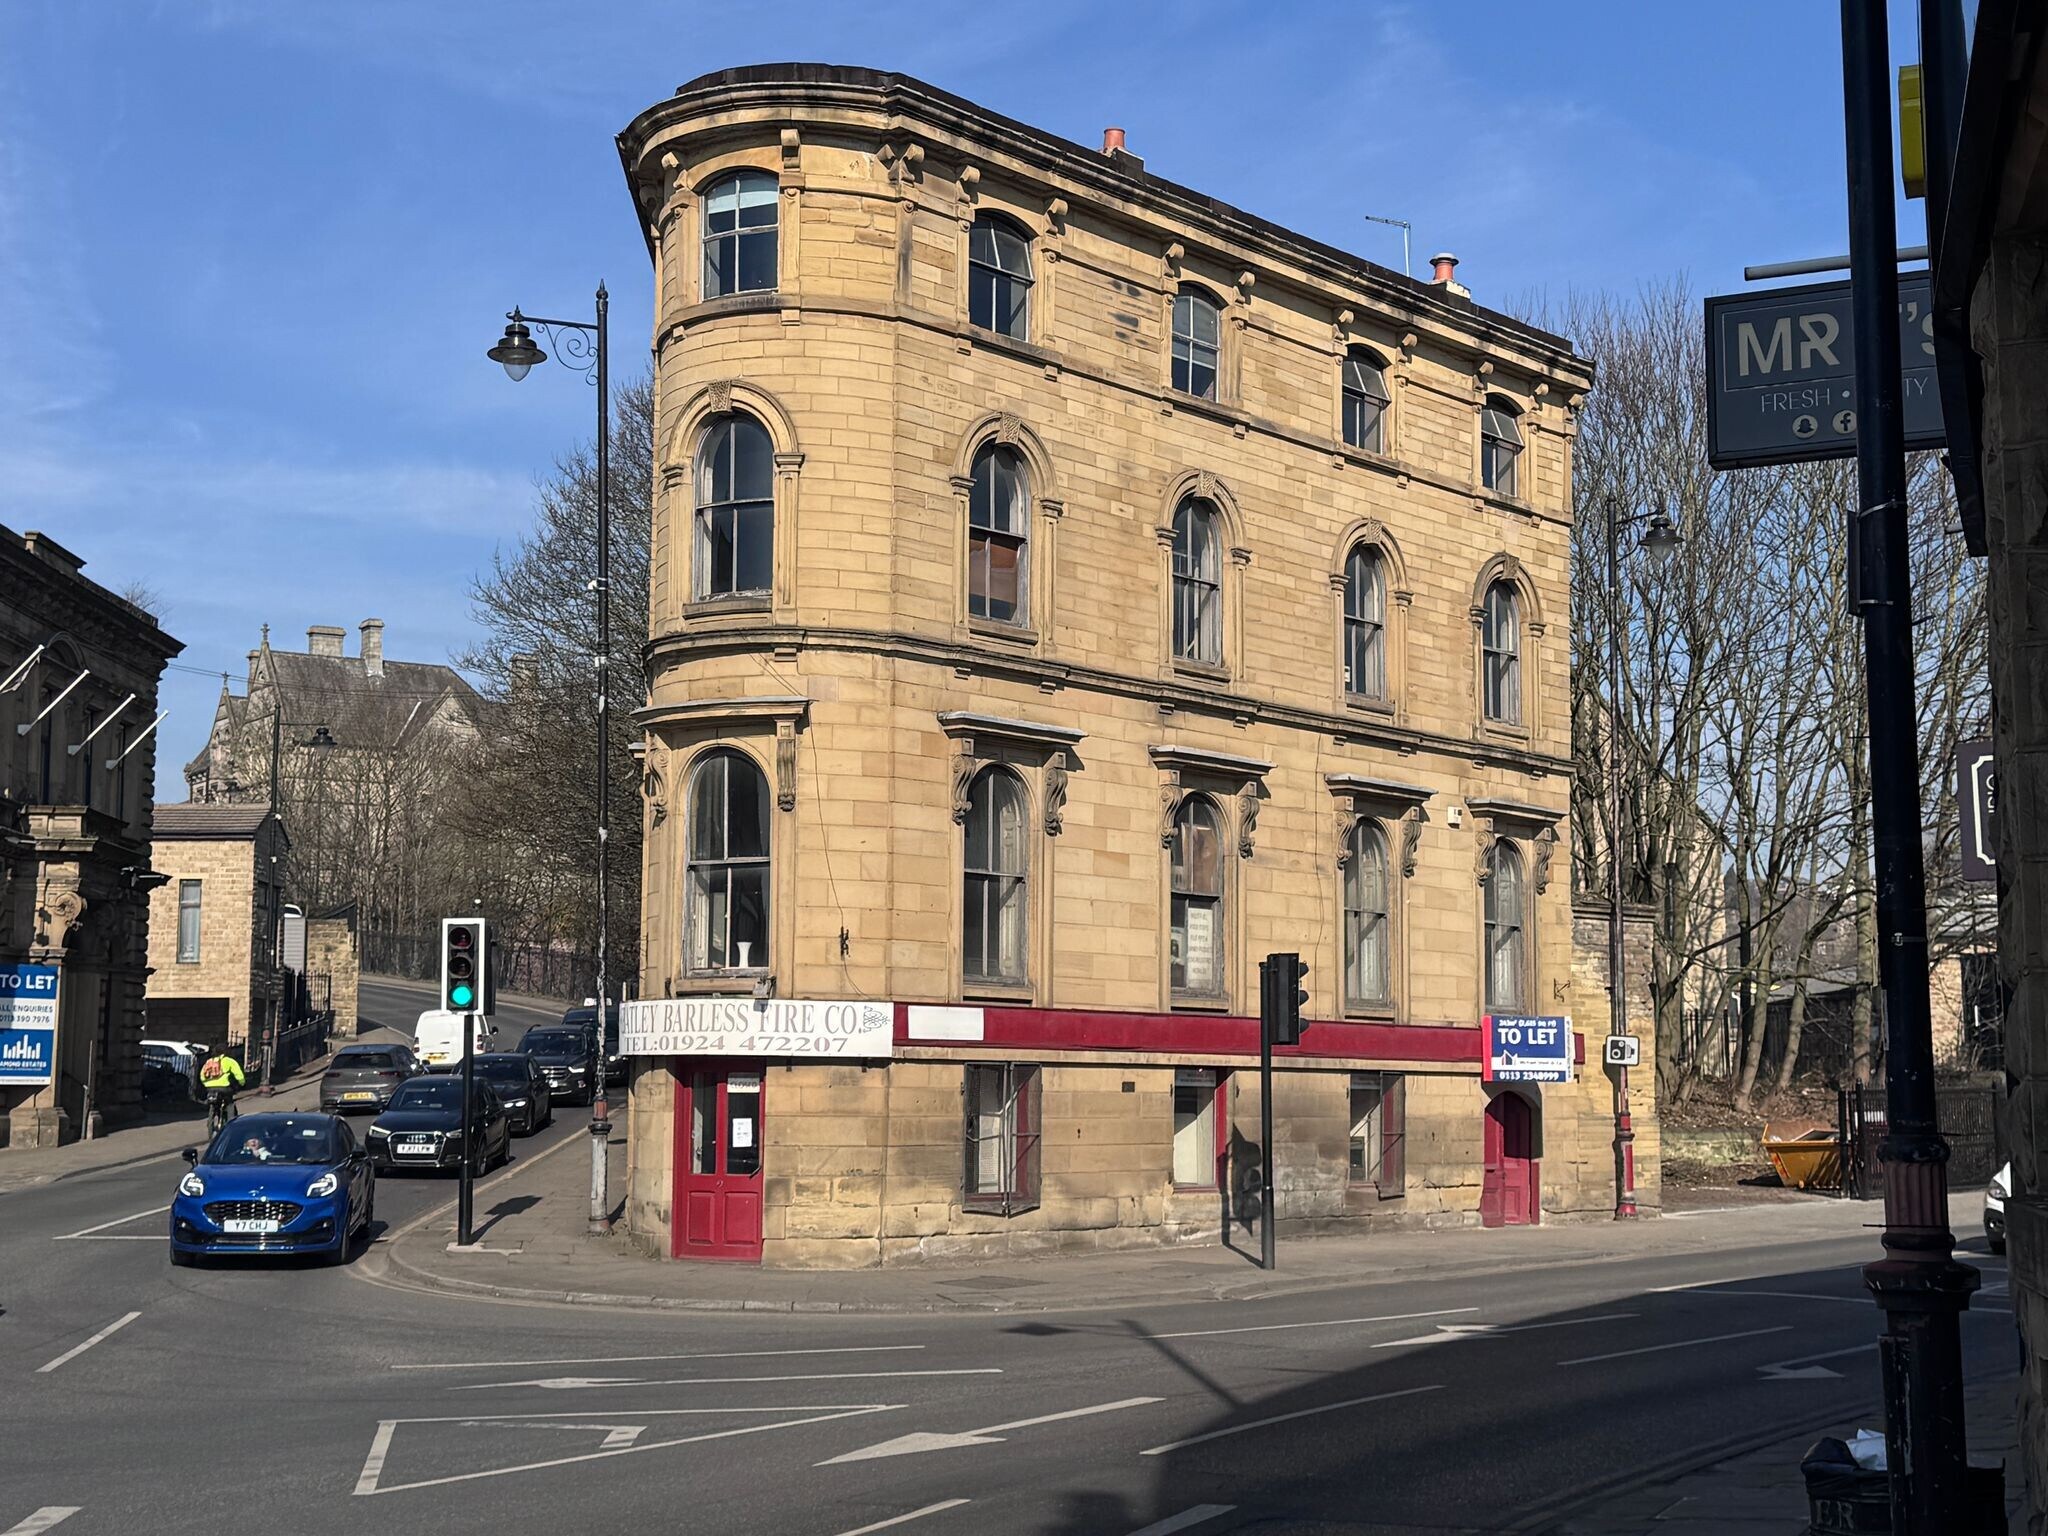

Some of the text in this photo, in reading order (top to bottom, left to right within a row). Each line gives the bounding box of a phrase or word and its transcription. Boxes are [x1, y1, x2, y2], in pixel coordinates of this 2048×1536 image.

[1738, 313, 1841, 376] MR
[1761, 388, 1831, 412] FRESH
[0, 974, 55, 990] TO LET
[13, 1005, 53, 1013] ENQUIRIES
[663, 1003, 749, 1033] BARLESS
[758, 1004, 815, 1033] FIRE
[824, 1005, 862, 1034] CO.
[739, 1036, 848, 1053] 472207
[1497, 1028, 1558, 1045] TO LET
[1499, 1071, 1520, 1080] 0113
[235, 1221, 268, 1230] Y7 CHJ
